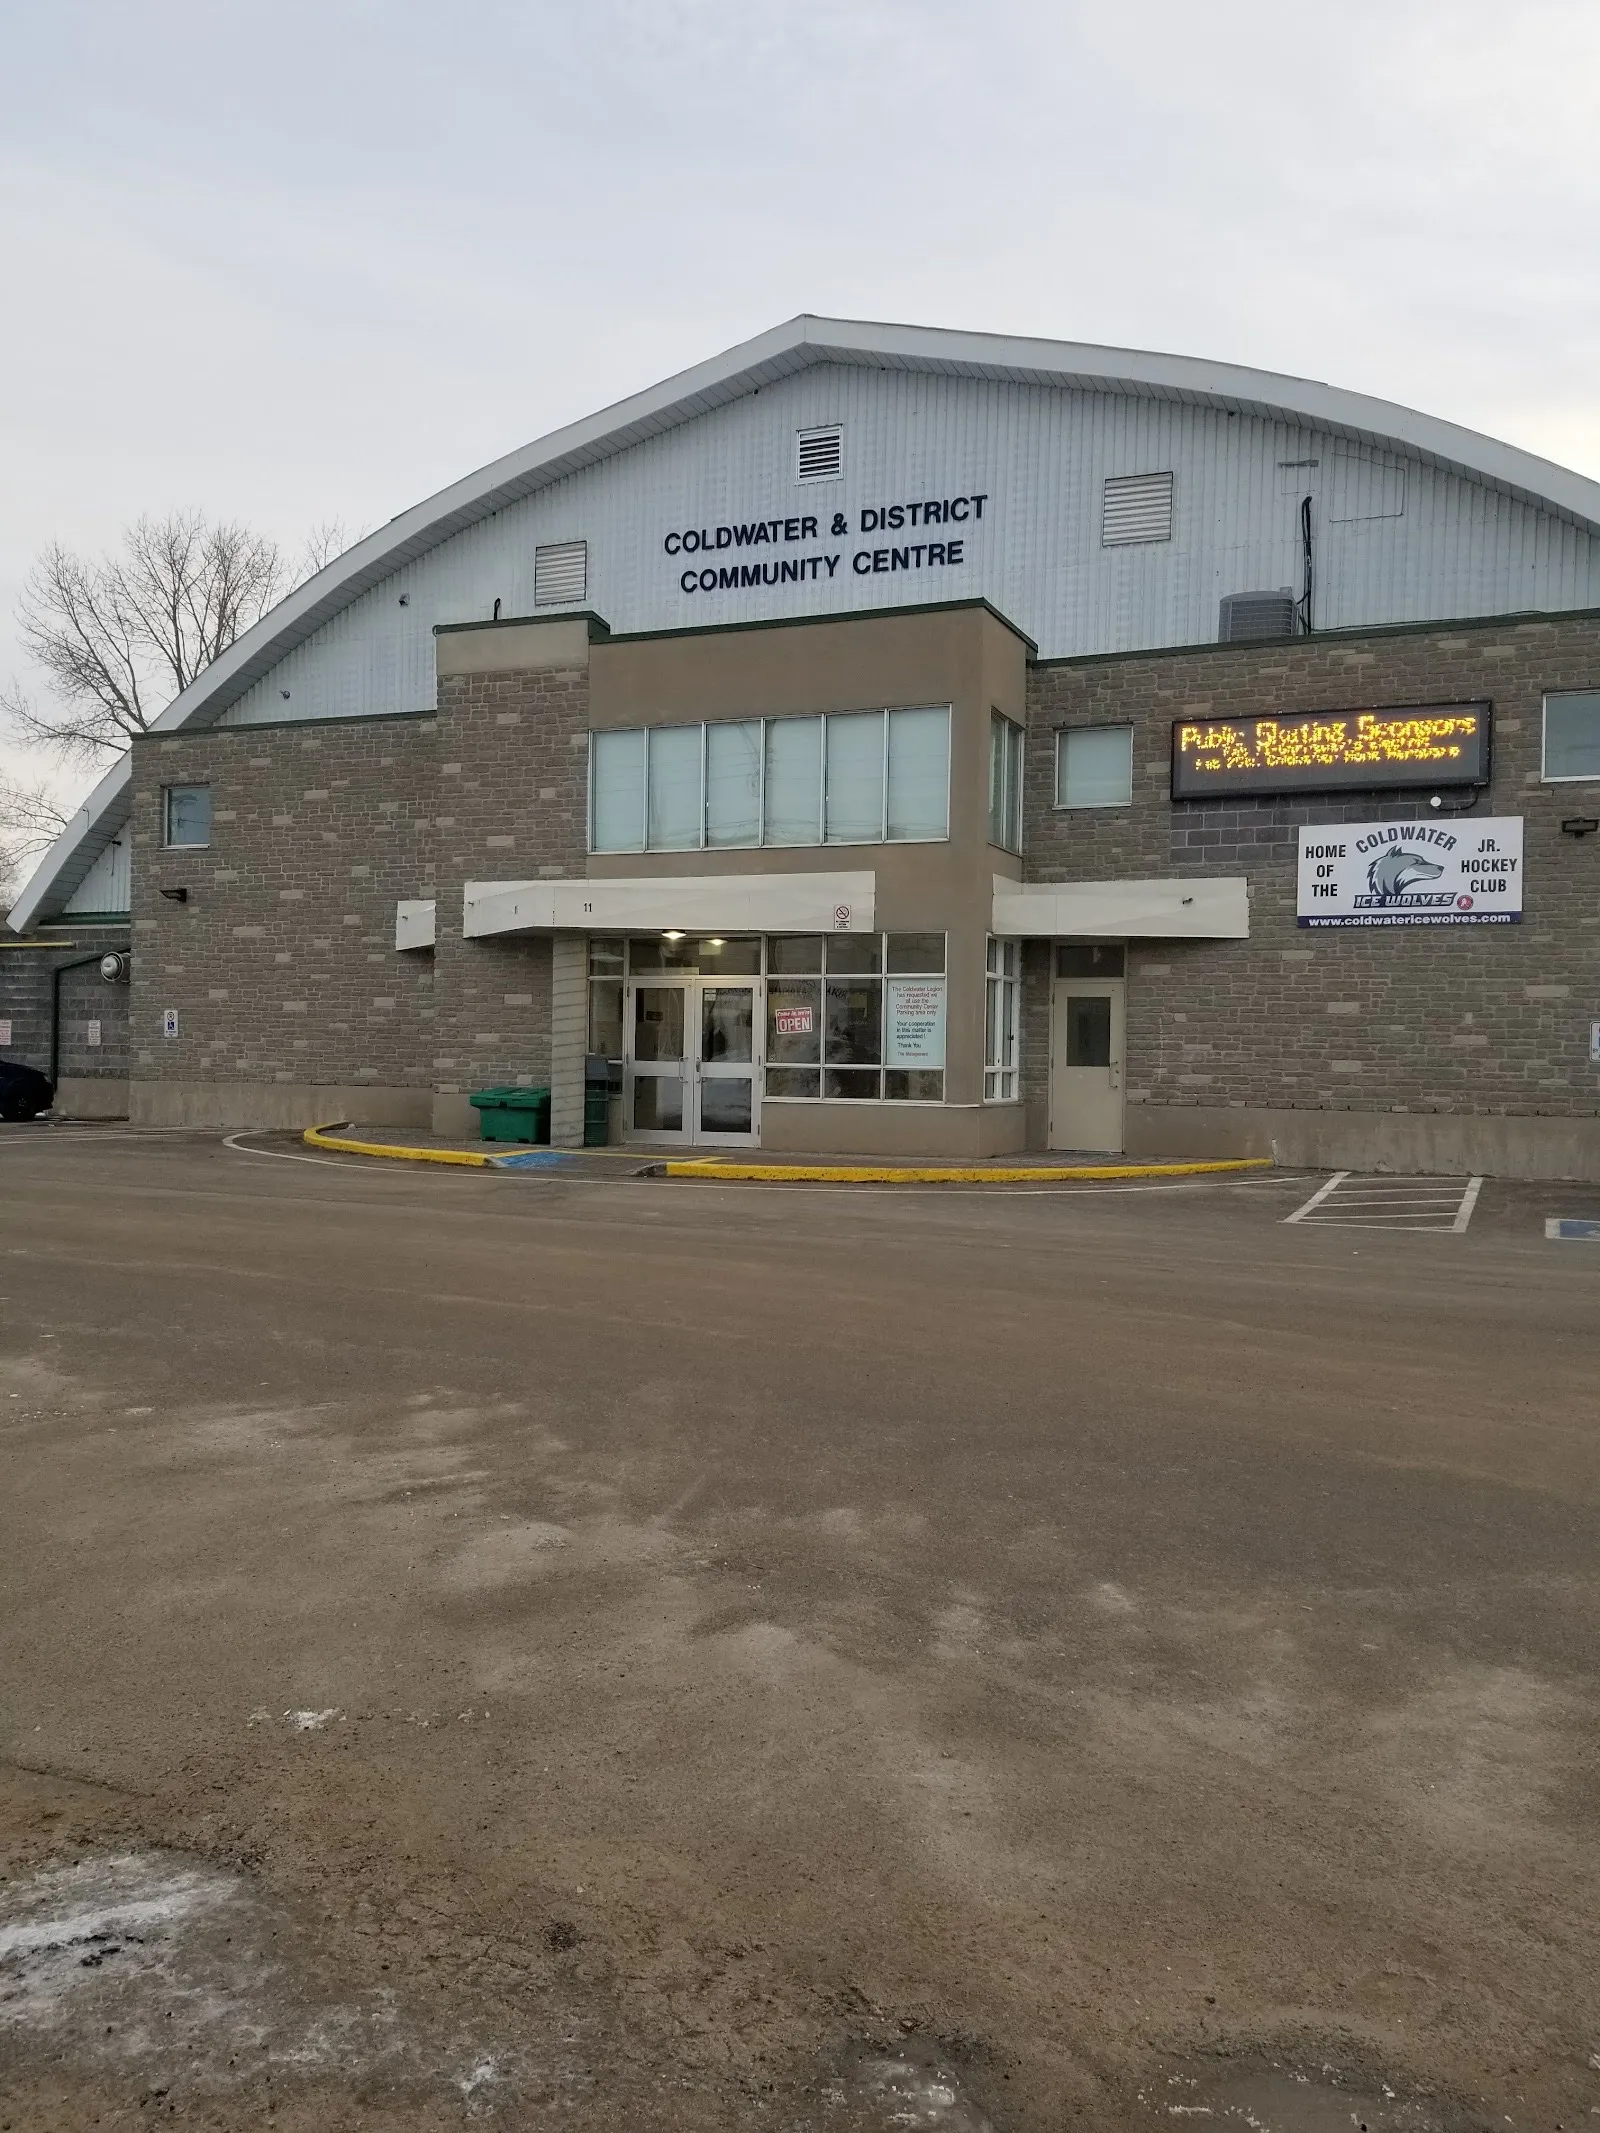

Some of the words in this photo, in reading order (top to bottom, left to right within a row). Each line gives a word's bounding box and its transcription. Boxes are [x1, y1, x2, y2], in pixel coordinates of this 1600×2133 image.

[664, 516, 818, 555] COLDWATER
[831, 512, 849, 536] &
[860, 494, 988, 533] DISTRICT
[680, 554, 841, 593] COMMUNITY
[852, 540, 964, 575] CENTRE
[1355, 826, 1458, 854] COLDWATER
[1477, 838, 1501, 853] JR.
[1305, 844, 1347, 859] HOME
[1316, 864, 1334, 878] OF
[1460, 858, 1518, 874] HOCKEY
[1311, 883, 1338, 898] THE
[1470, 878, 1507, 893] CLUB
[583, 902, 592, 913] 11
[1355, 894, 1382, 908] ICE
[1384, 892, 1456, 908] WOLVES
[1308, 913, 1511, 927] www.coldwatericewolves.com
[778, 1017, 810, 1032] OPEN
[908, 1020, 936, 1028] cooperation
